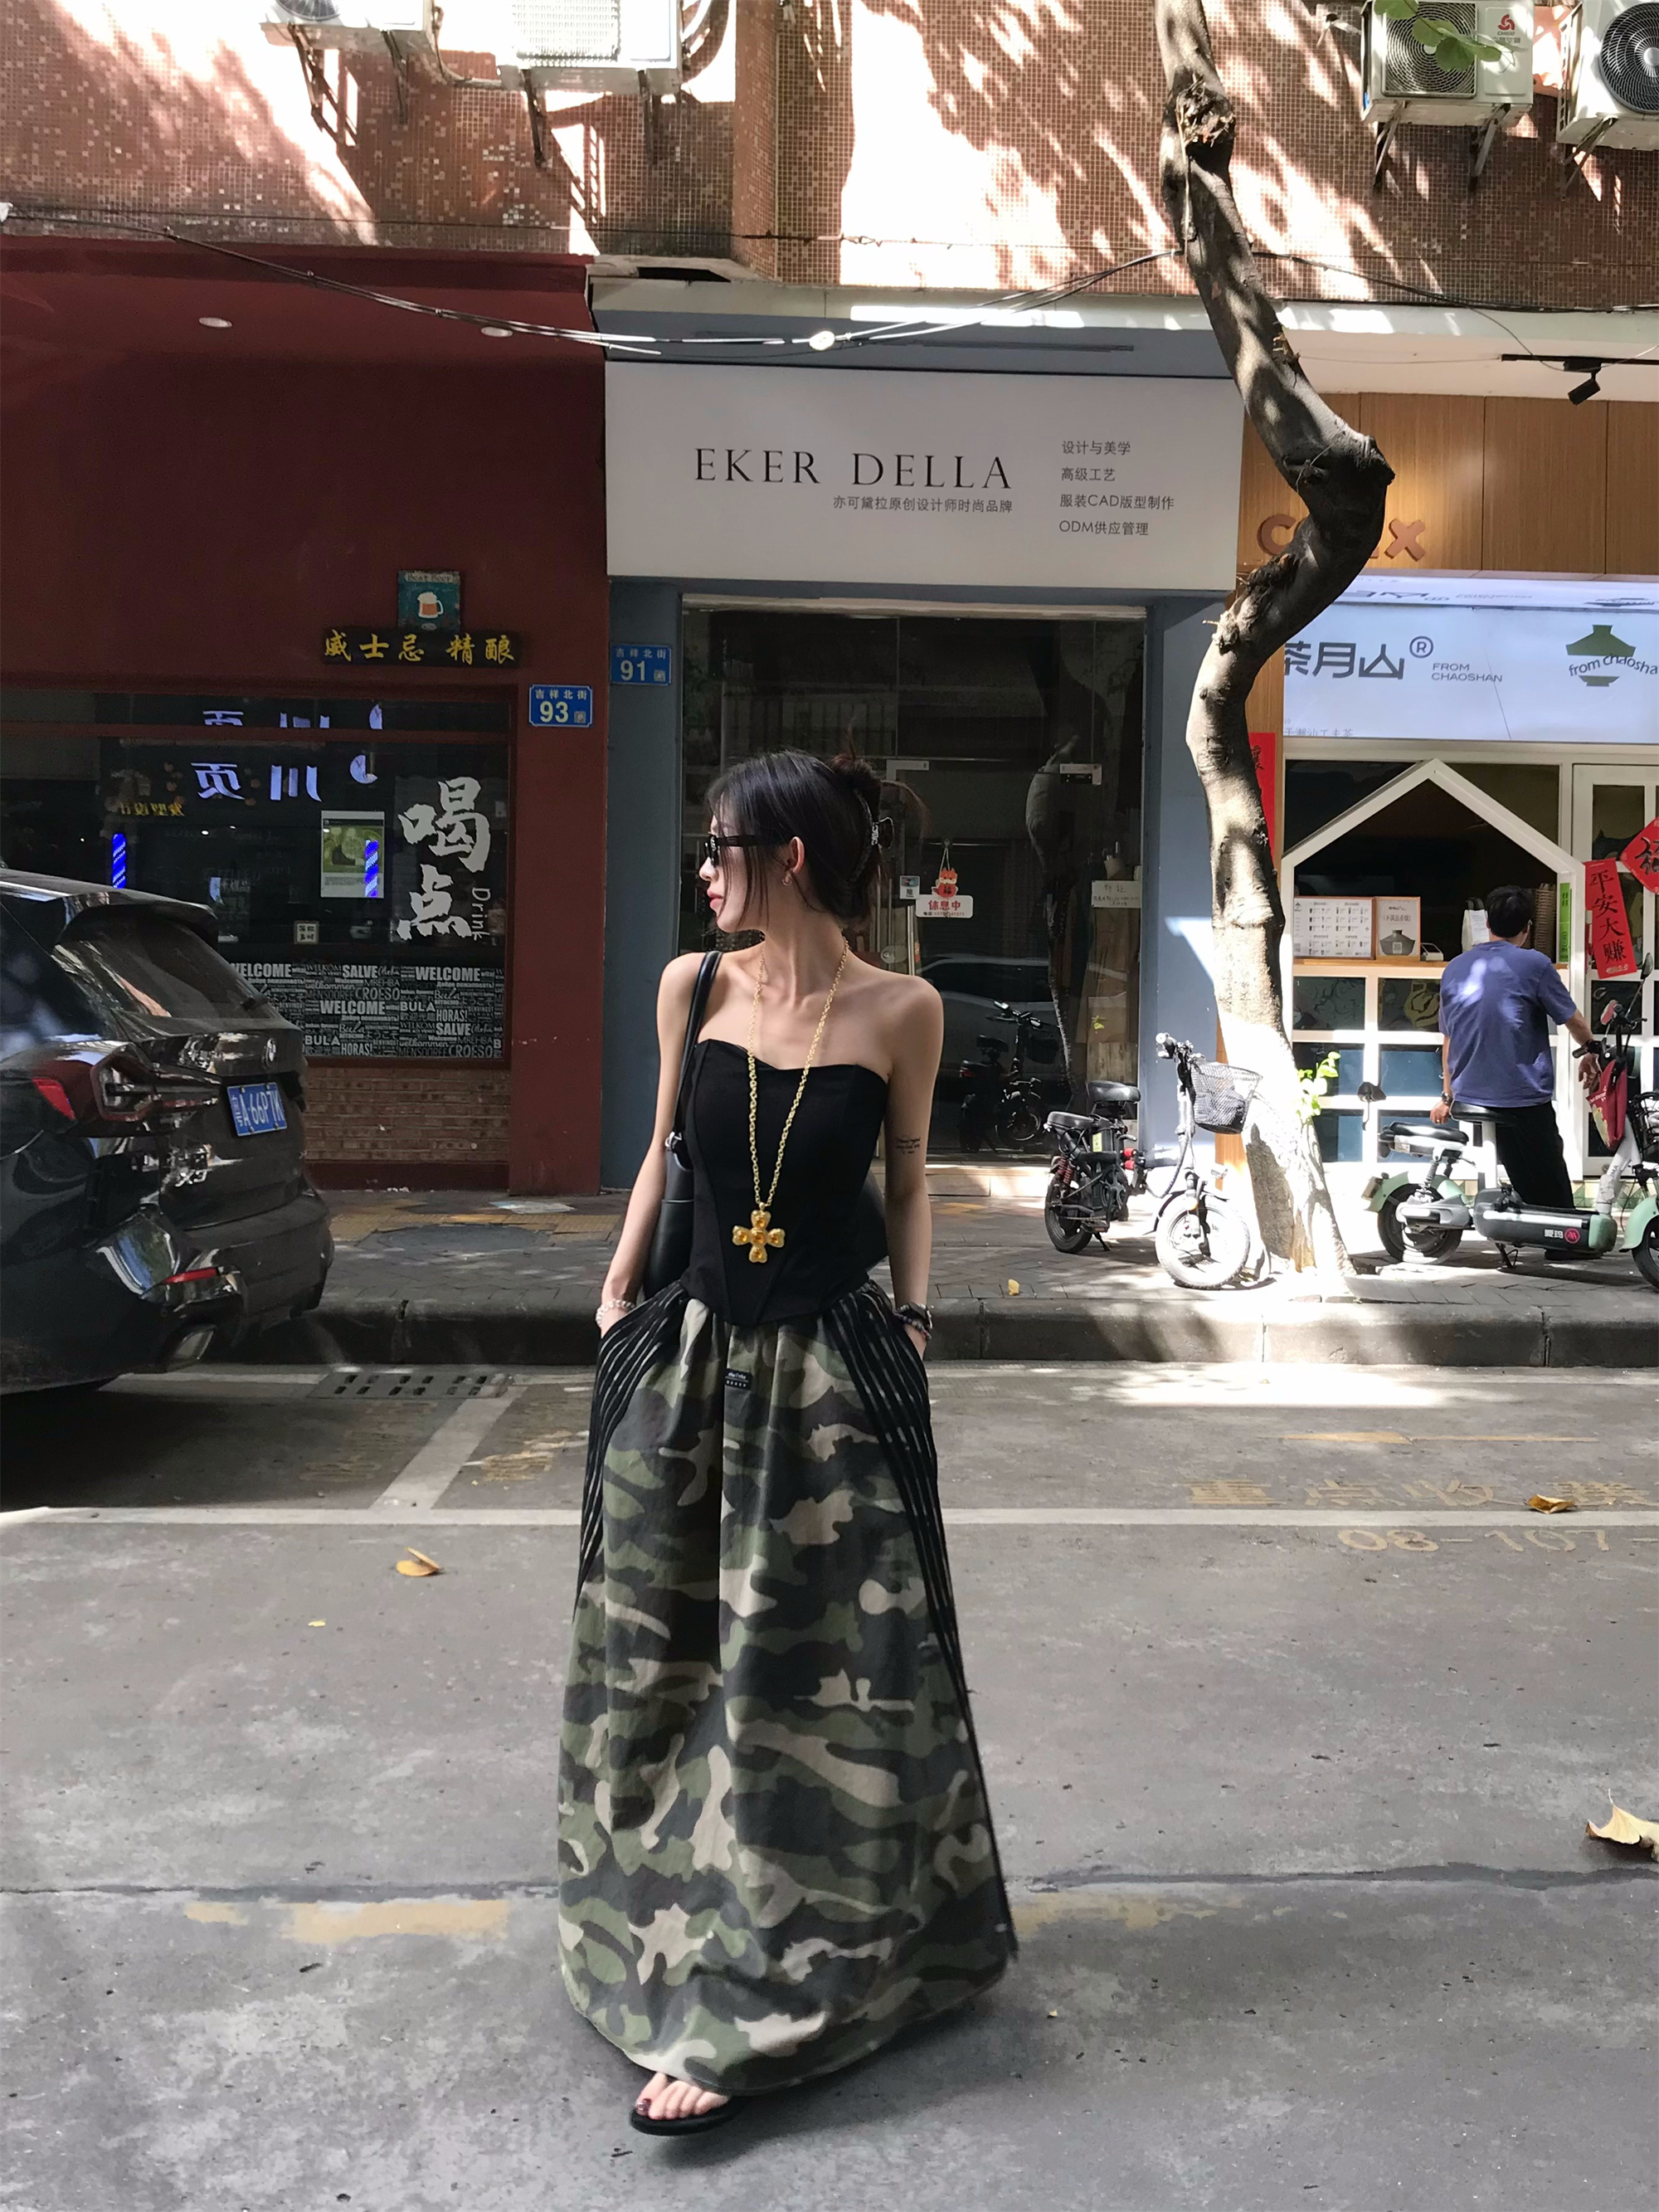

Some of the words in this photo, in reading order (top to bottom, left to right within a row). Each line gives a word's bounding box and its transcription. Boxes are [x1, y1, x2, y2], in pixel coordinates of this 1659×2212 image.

[1062, 441, 1131, 456] 设计与美学
[694, 448, 821, 484] EKER
[851, 452, 1012, 490] DELLA
[1061, 467, 1116, 481] 高级工艺
[833, 495, 1013, 513] 亦可黛拉原创设计师时尚品牌
[1059, 494, 1175, 510] 服装CAD版型制作
[1058, 520, 1149, 535] ODM供应管理
[324, 629, 426, 662] 威士忌
[445, 633, 514, 665] 精酿
[615, 648, 666, 659] 吉祥北街
[620, 660, 645, 681] 91
[1432, 663, 1470, 671] FROM
[1569, 658, 1602, 676] from
[1603, 653, 1659, 676] chaosha
[1431, 672, 1503, 683] CHAOSHAN
[535, 689, 587, 700] 吉祥北街
[540, 700, 569, 723] 93
[397, 775, 491, 941] 喝点
[928, 899, 961, 911] 休息中
[470, 887, 492, 942] Drink
[1588, 869, 1627, 964] 平安大赚
[342, 964, 378, 978] SALVE
[415, 966, 481, 982] WELCOME
[355, 987, 401, 1001] CROESO
[319, 1000, 387, 1015] WELCOME
[400, 1001, 436, 1012] BULA
[436, 1009, 468, 1022] HORAS!
[435, 1022, 471, 1036] SALVE
[304, 1035, 341, 1045] BULA
[341, 1042, 373, 1056] HORAS!
[448, 1044, 494, 1060] CROESO
